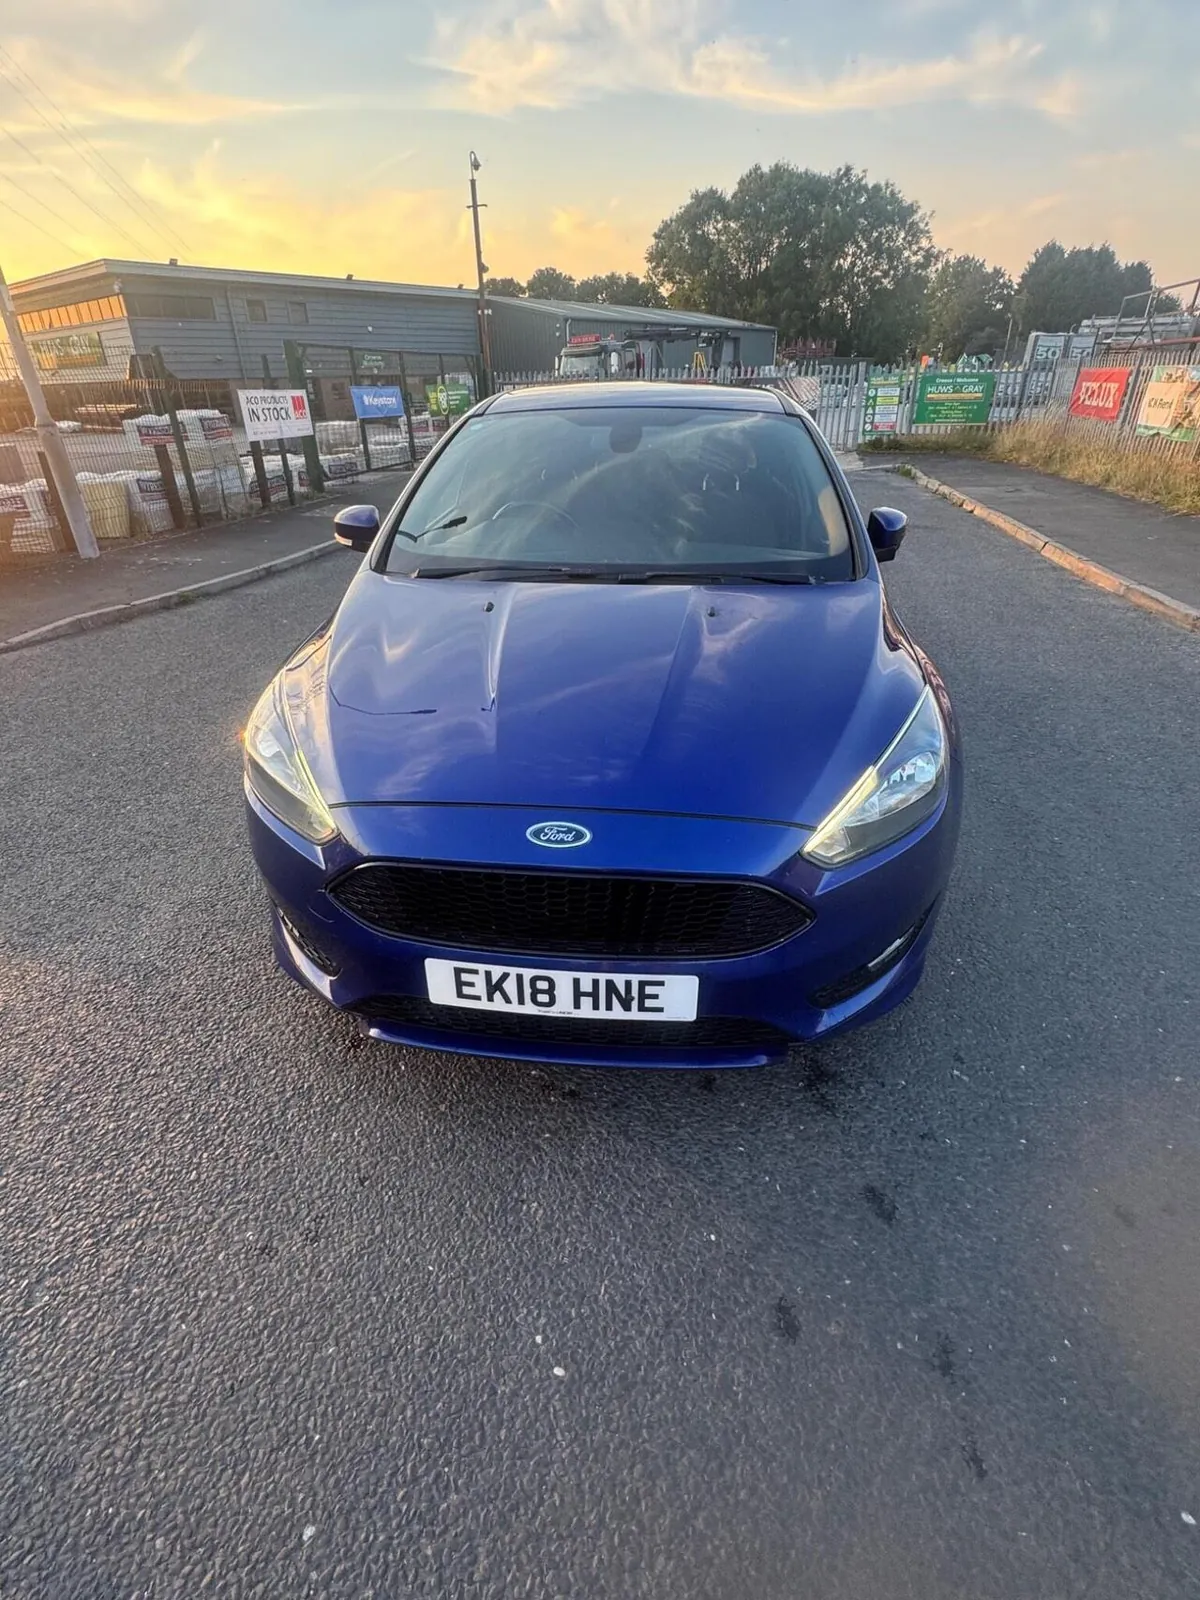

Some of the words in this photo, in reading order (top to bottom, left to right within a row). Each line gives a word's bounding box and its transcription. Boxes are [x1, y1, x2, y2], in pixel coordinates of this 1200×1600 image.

[1036, 348, 1060, 359] 50
[927, 385, 953, 393] HUWS
[962, 385, 984, 393] GRAY
[1078, 381, 1120, 408] VELUX
[260, 395, 288, 404] PRODUCTS
[248, 408, 260, 423] IN
[262, 407, 292, 422] STOCK
[540, 826, 576, 843] Ford
[453, 966, 557, 1009] EK18
[572, 976, 666, 1013] HNE
